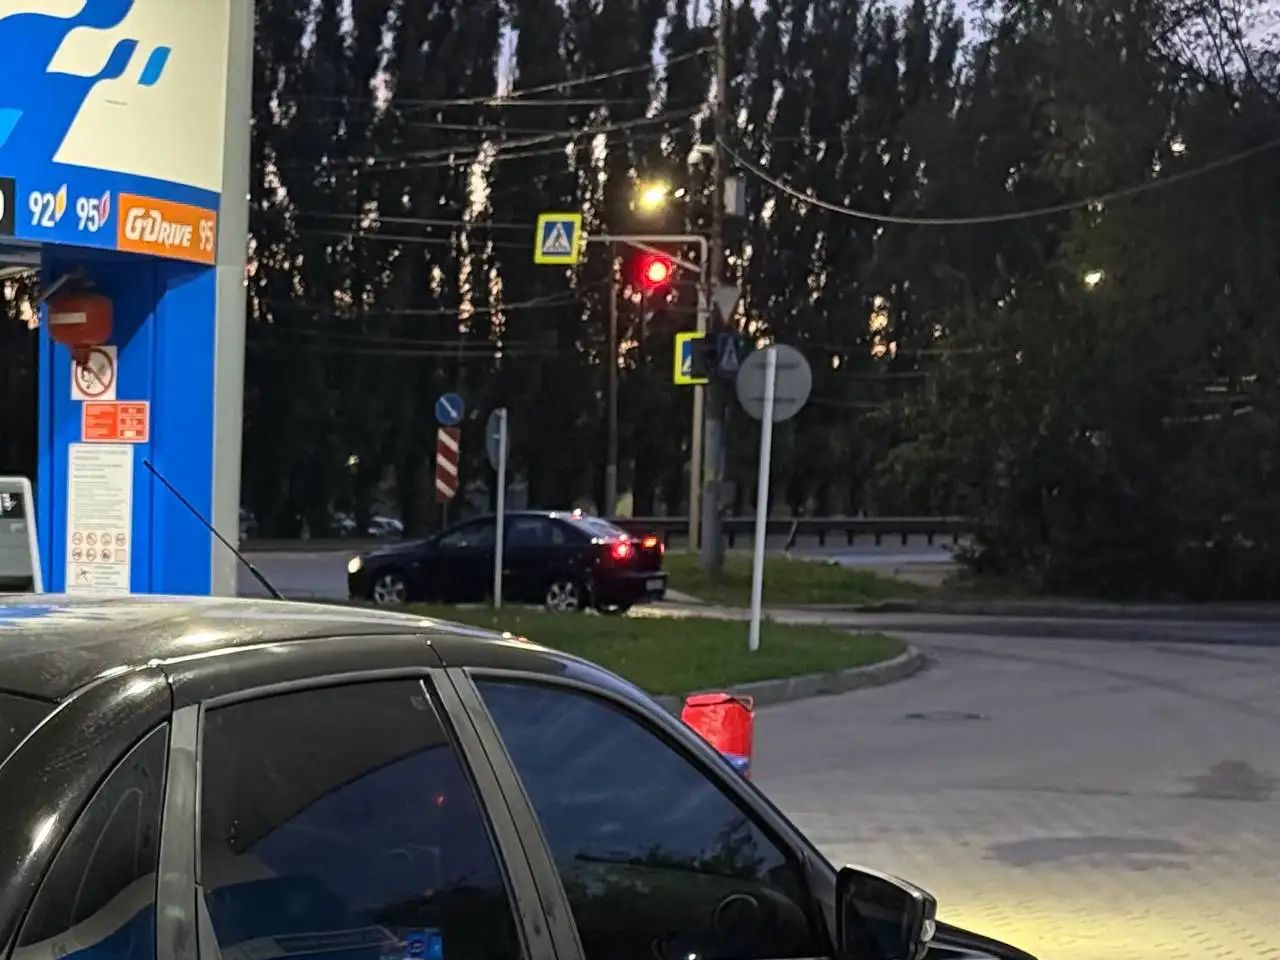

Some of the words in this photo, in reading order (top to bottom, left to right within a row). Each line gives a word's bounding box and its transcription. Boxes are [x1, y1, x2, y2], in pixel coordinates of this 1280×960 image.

[28, 191, 56, 228] 92
[76, 196, 100, 233] 95
[199, 218, 215, 252] 95
